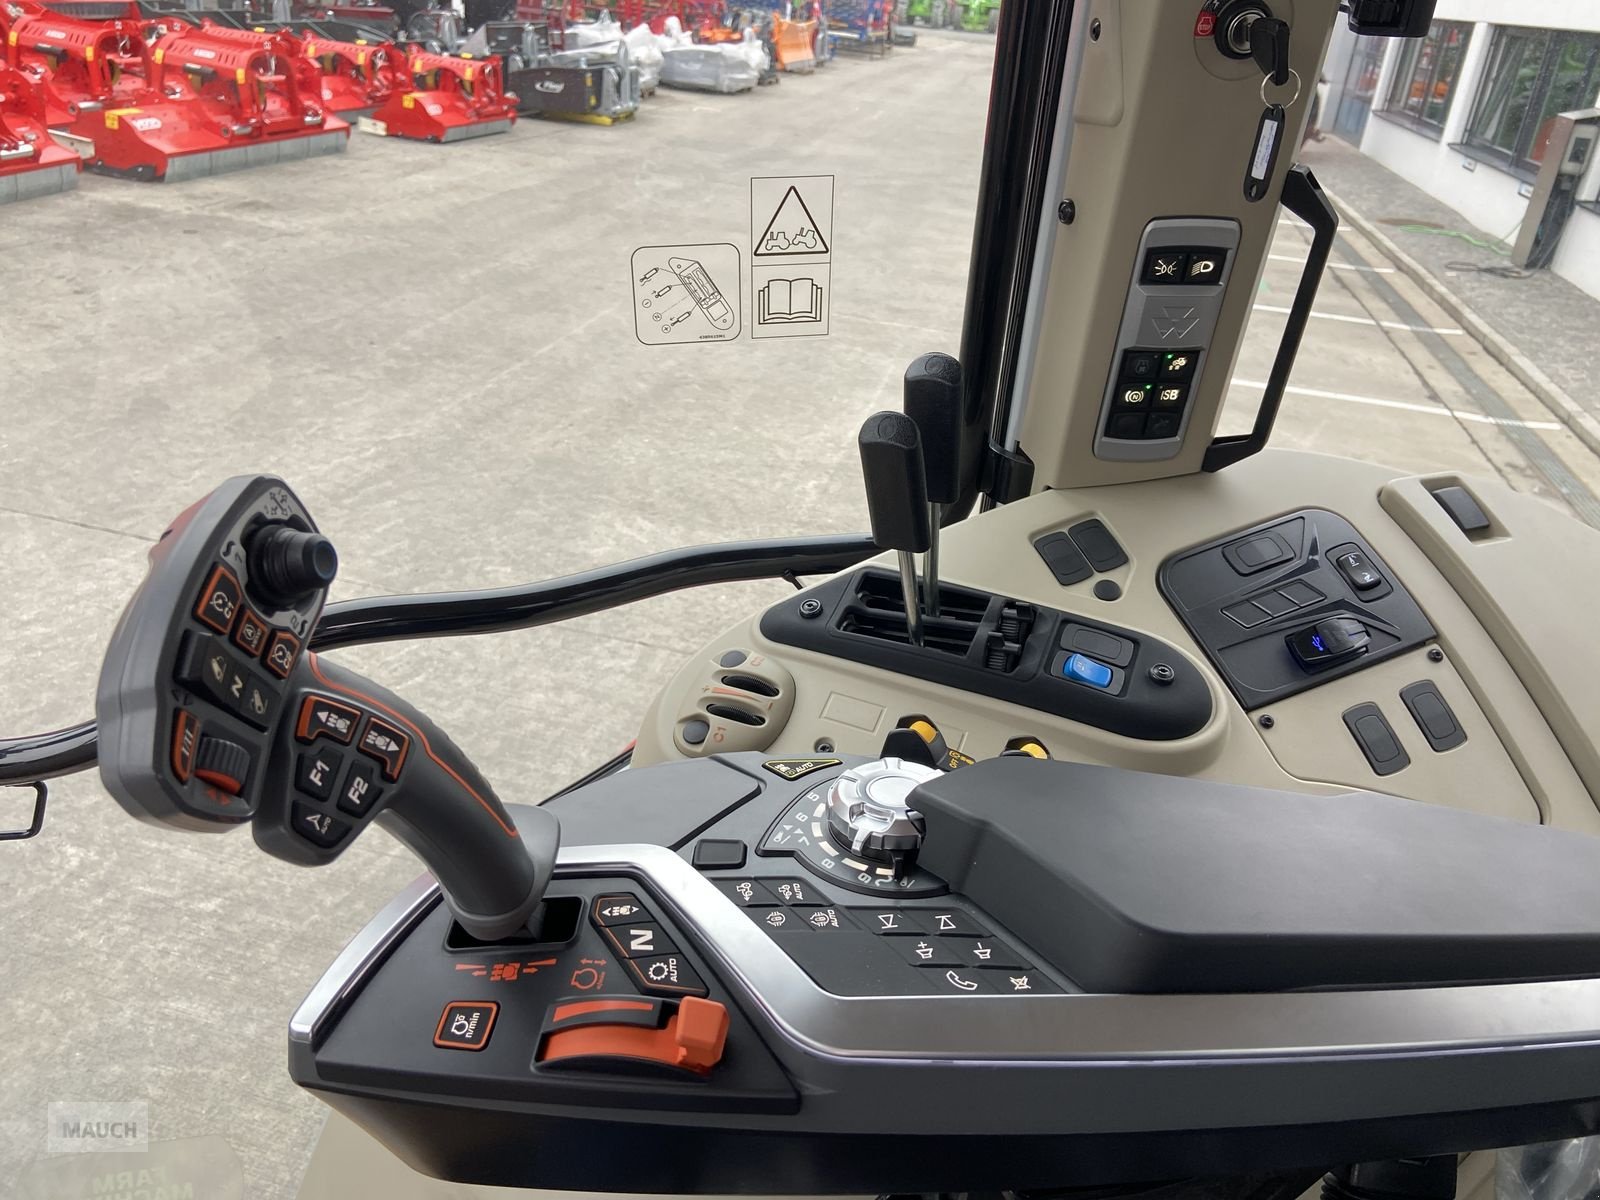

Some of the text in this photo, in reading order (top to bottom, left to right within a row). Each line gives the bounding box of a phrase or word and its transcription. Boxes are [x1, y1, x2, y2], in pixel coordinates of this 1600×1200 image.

[1160, 389, 1180, 401] ISB
[309, 759, 330, 787] F1
[795, 761, 814, 773] AUTO
[347, 776, 369, 805] F2
[806, 791, 820, 802] 5
[820, 858, 836, 870] 8
[792, 883, 804, 900] AUTO
[827, 909, 840, 928] AUTO
[629, 928, 654, 951] N
[668, 958, 678, 983] AUTO
[464, 1012, 481, 1039] n/min
